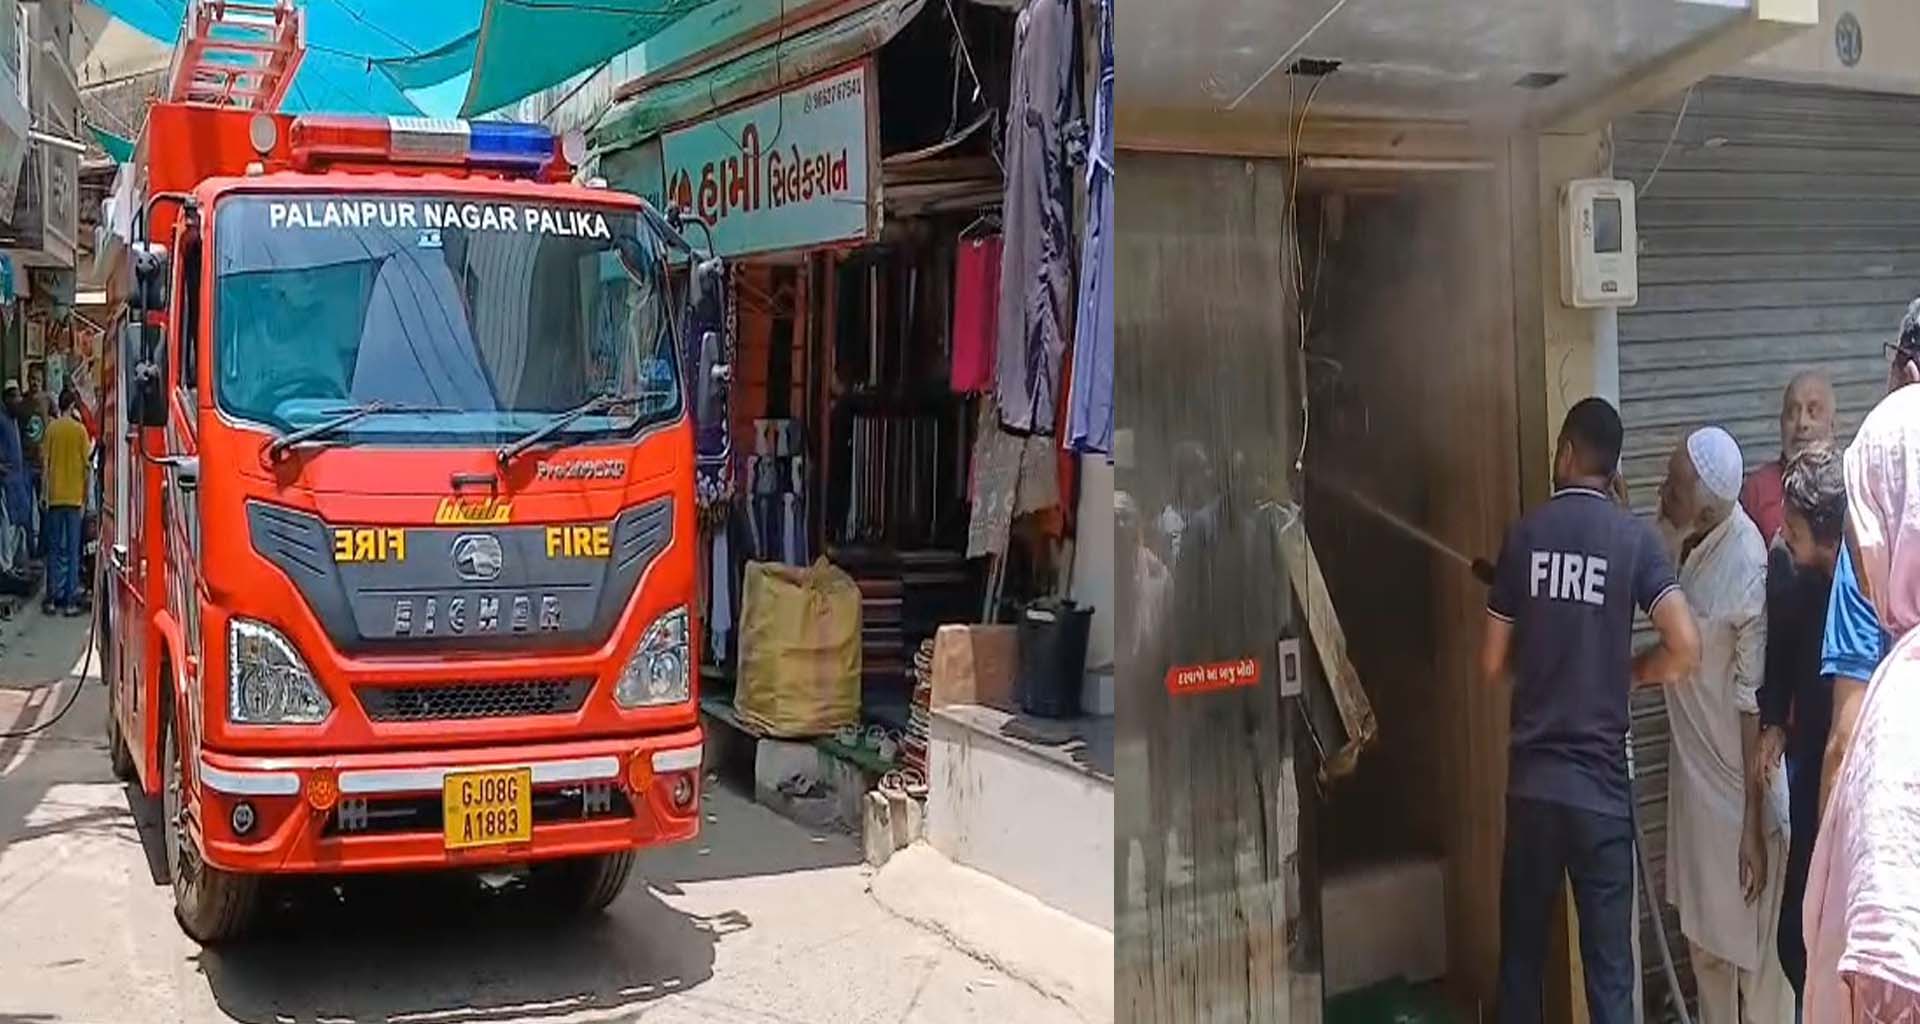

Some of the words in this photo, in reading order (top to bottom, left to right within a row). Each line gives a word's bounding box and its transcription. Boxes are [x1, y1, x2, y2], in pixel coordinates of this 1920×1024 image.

[699, 123, 760, 226] હામી
[269, 202, 418, 228] PALANPUR
[424, 203, 518, 231] NAGAR
[524, 208, 612, 239] PALIKA
[545, 526, 611, 558] FIRE
[1530, 551, 1608, 605] FIRE
[395, 594, 562, 635] EICHER
[462, 776, 518, 806] GJ08G
[463, 808, 519, 841] A1883
